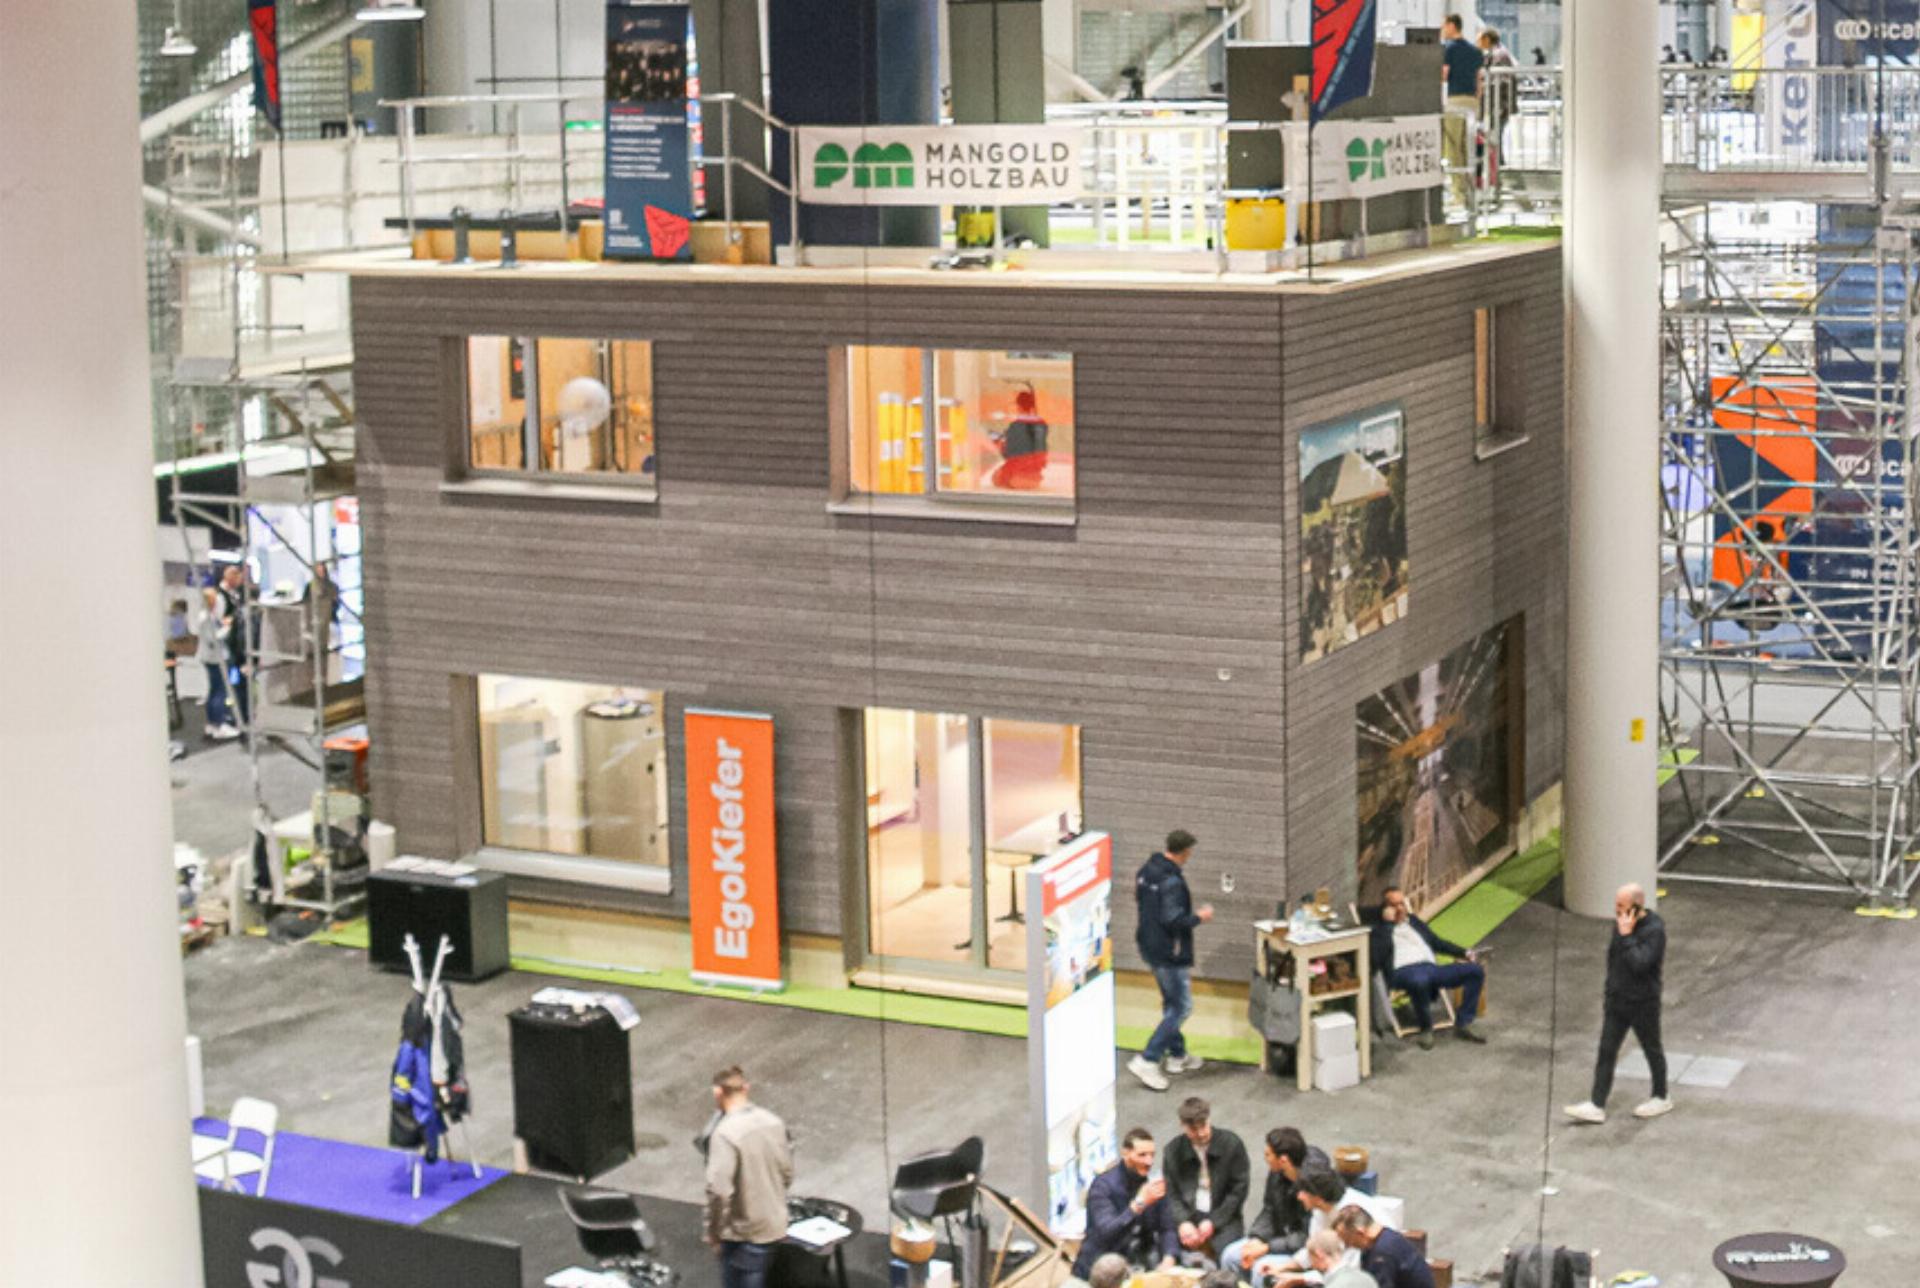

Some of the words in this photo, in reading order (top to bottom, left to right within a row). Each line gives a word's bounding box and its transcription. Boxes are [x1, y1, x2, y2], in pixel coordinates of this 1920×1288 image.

[926, 143, 1070, 164] MANGOLD
[926, 167, 1070, 190] HOLZBAU
[711, 737, 754, 959] EgoKiefer
